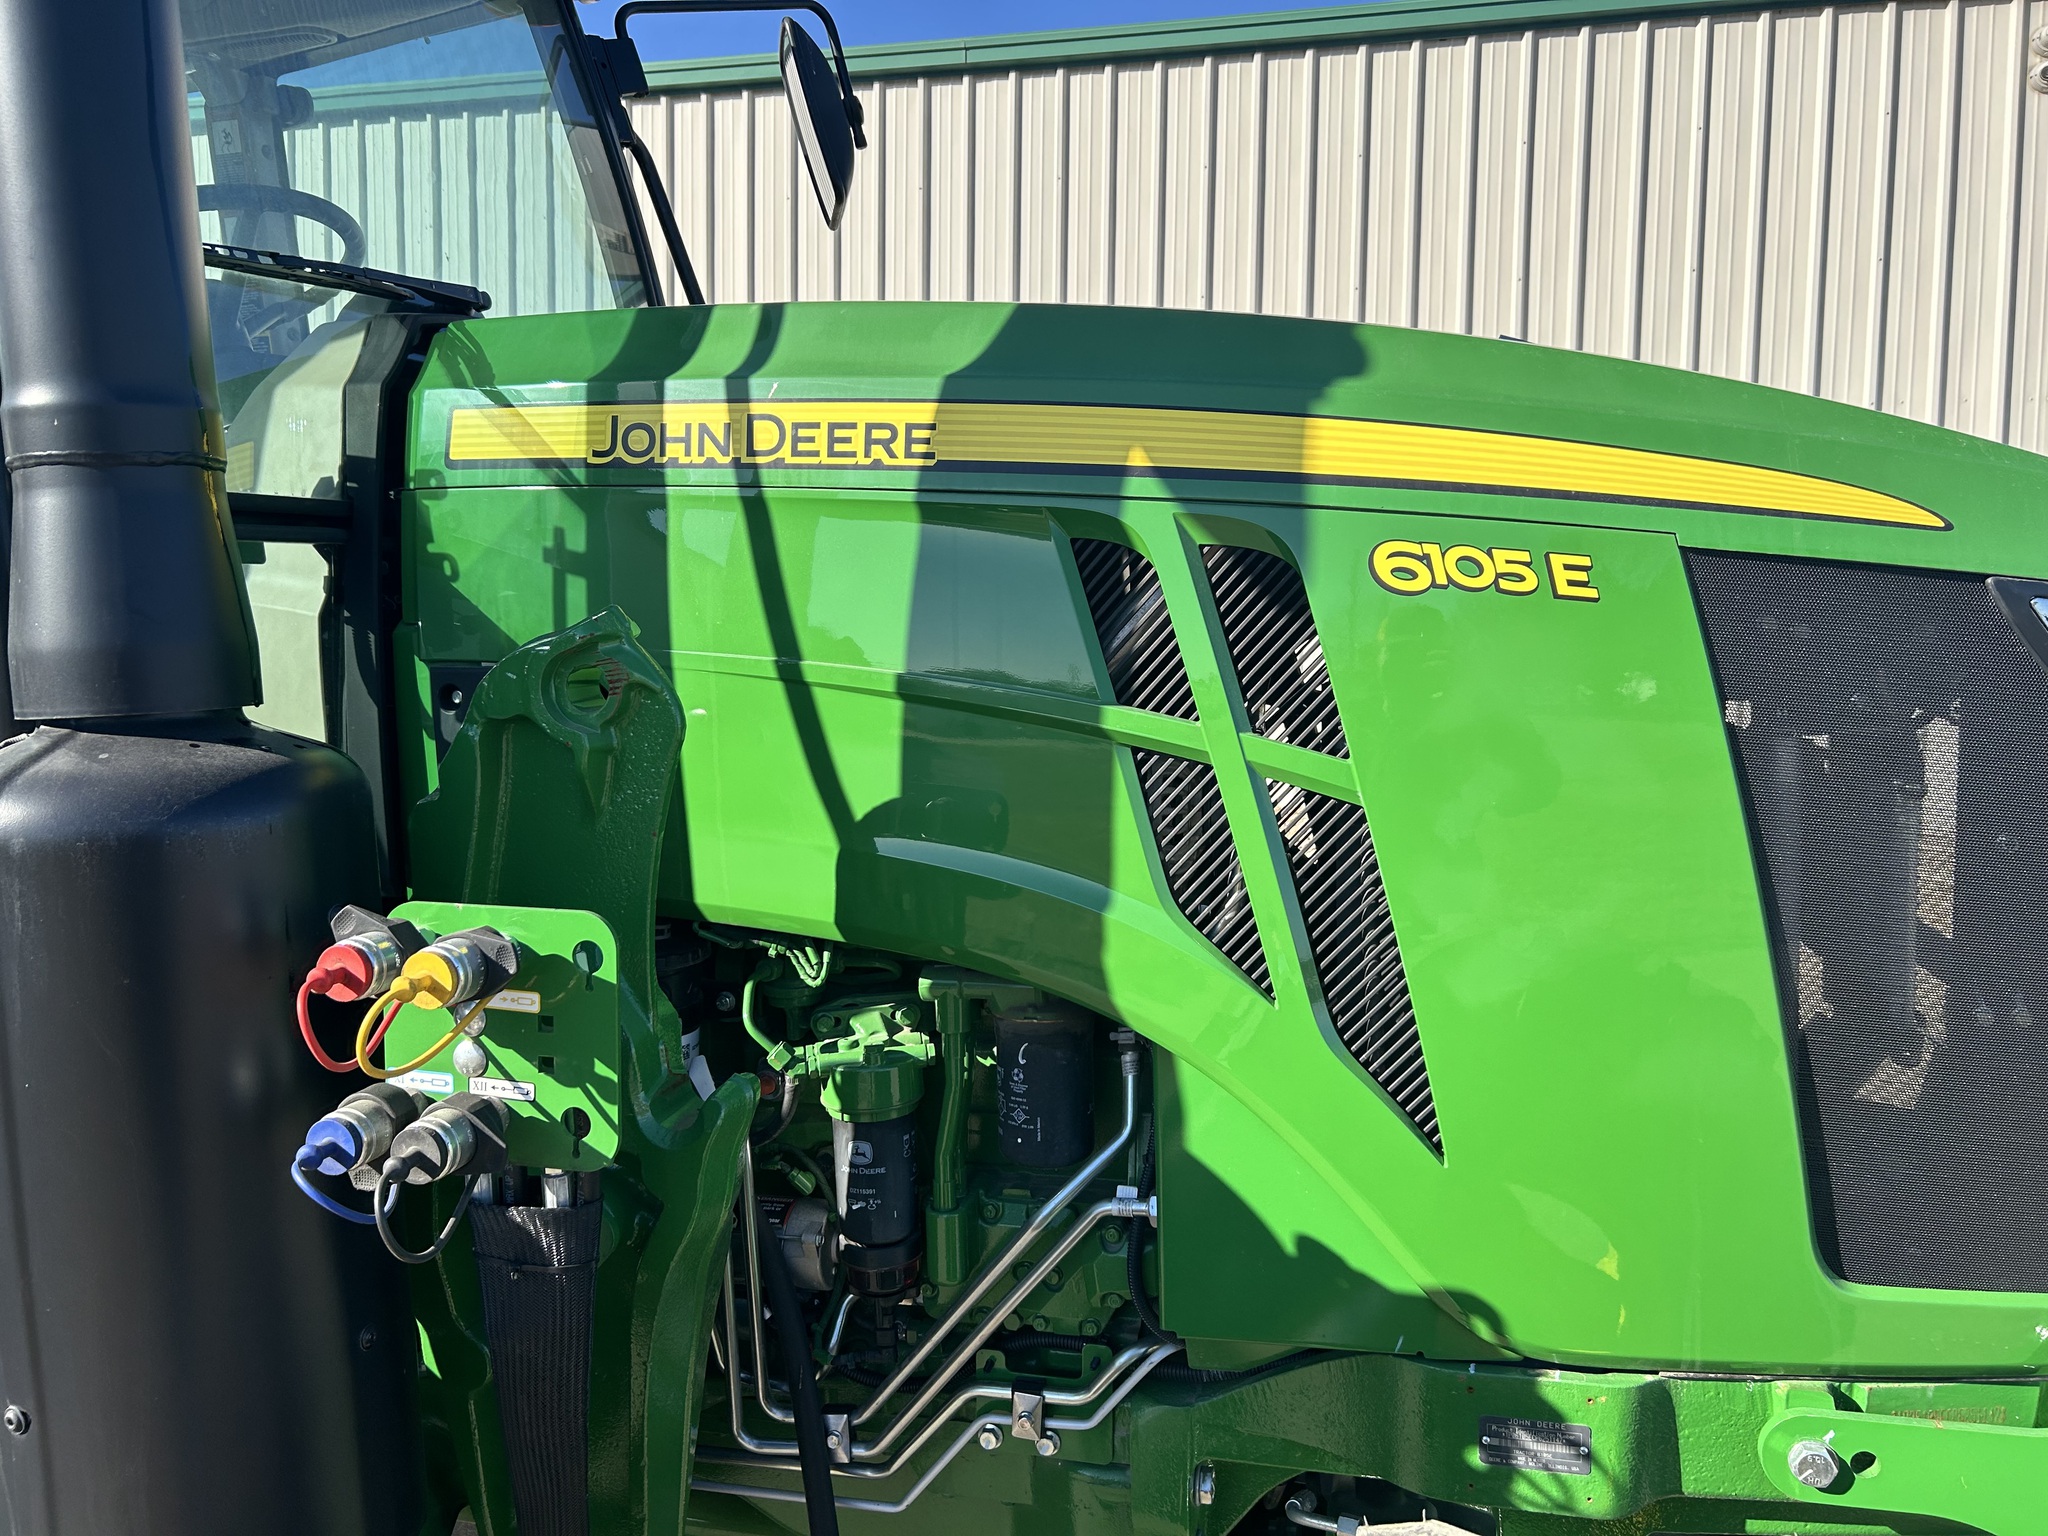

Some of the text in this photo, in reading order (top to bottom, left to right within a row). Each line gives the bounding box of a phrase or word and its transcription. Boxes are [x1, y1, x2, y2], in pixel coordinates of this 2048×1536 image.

[589, 413, 937, 463] JOHN DEERE
[1368, 539, 1600, 602] 6105 E
[472, 1080, 487, 1092] XII
[841, 1164, 887, 1175] JOHN DEERE
[1507, 1418, 1566, 1430] JOHN DEERE
[1492, 1424, 1512, 1432] Product
[1557, 1432, 1576, 1440] Number
